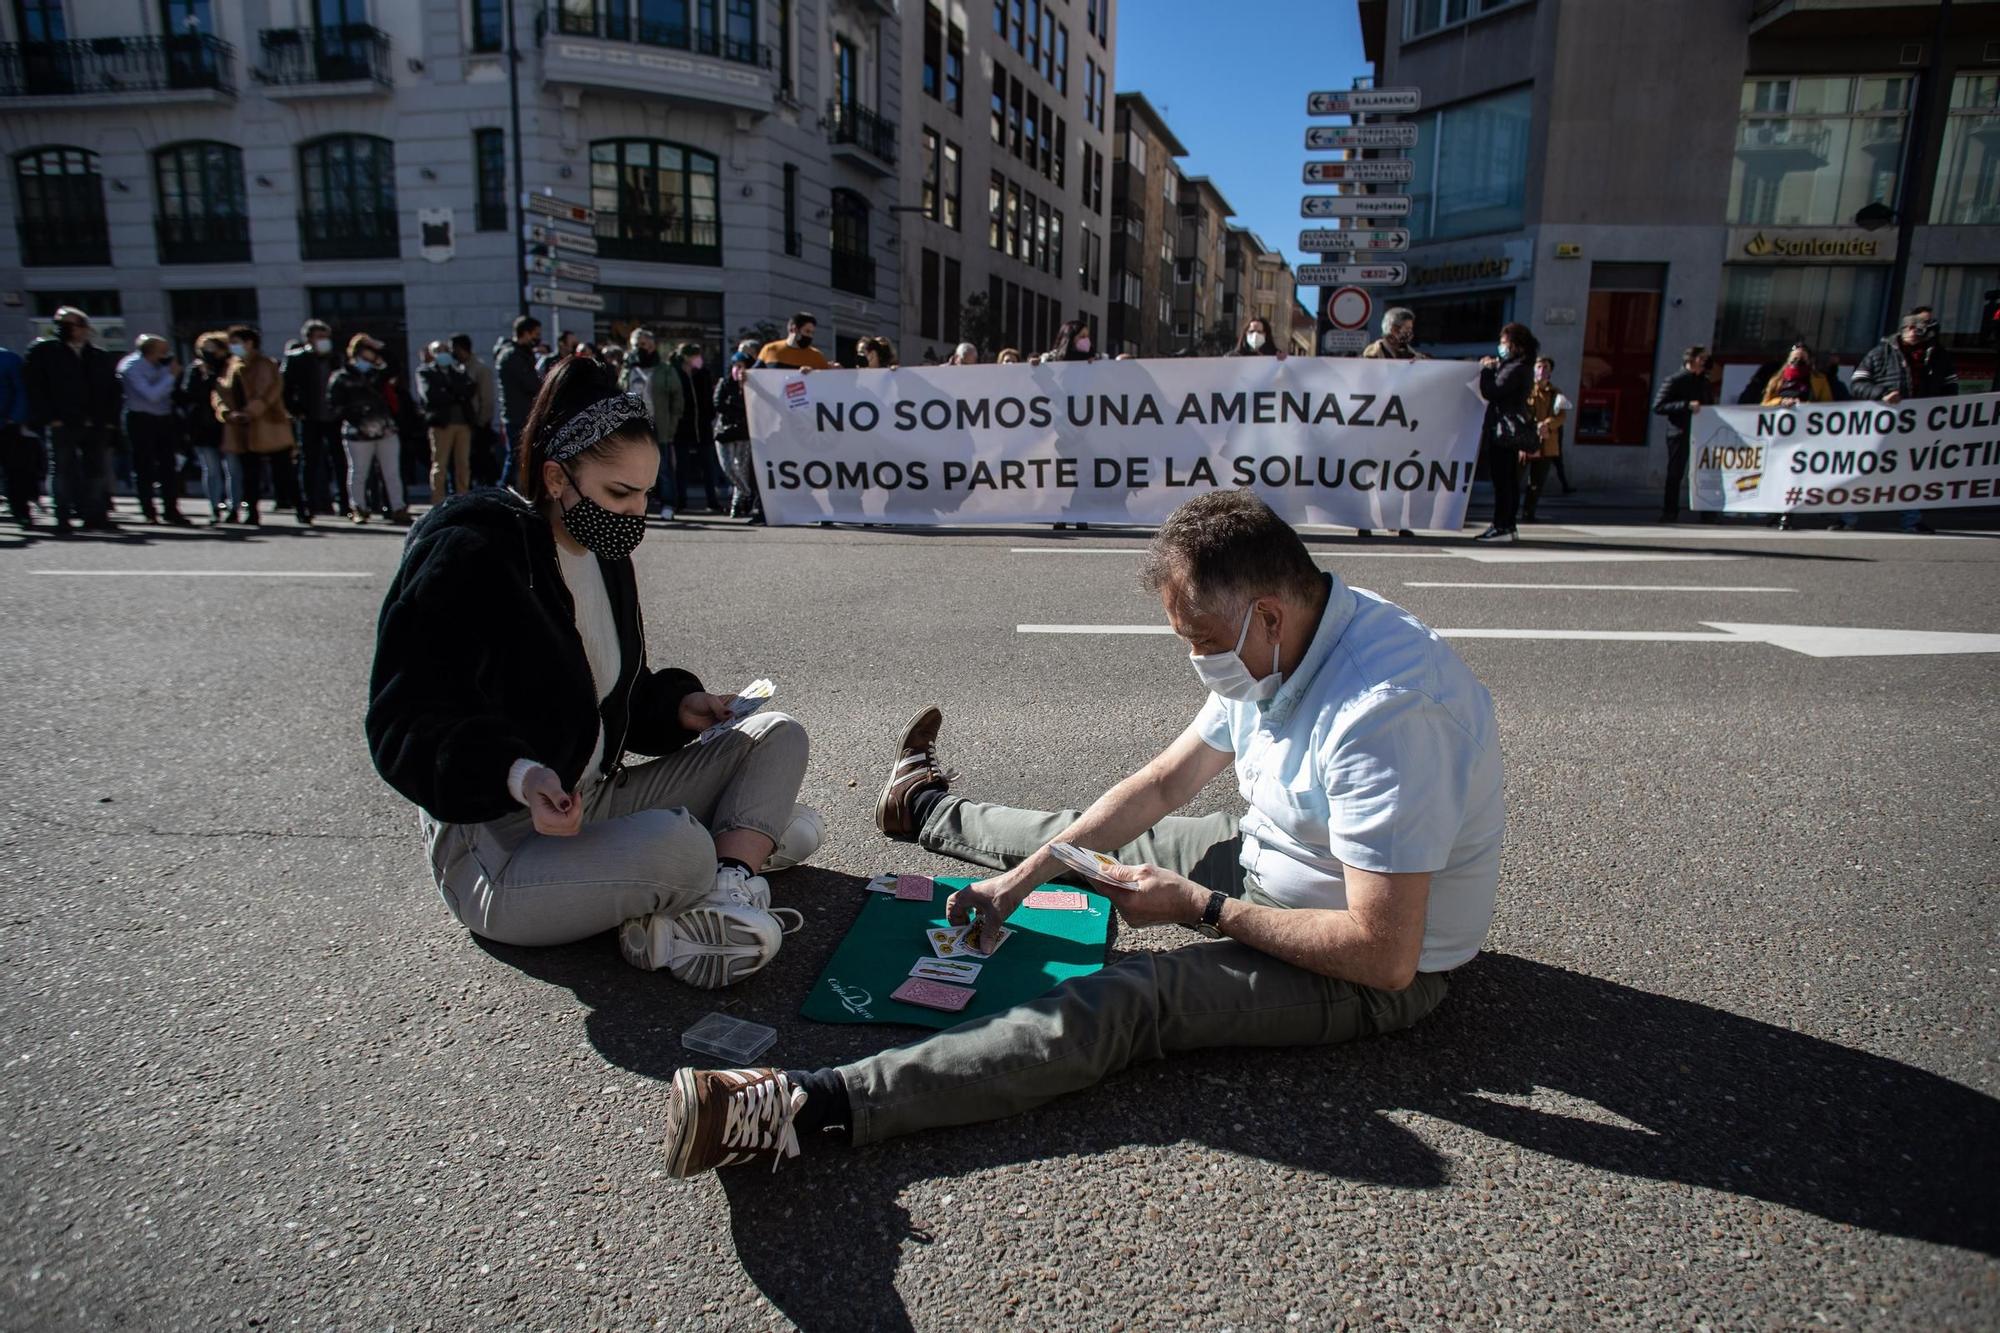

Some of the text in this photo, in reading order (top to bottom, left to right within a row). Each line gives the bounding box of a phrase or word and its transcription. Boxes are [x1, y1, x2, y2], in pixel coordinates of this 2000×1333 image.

[1354, 96, 1415, 105] SALAMANCA
[1356, 202, 1407, 211] Hospitales
[1773, 237, 1878, 256] Santander
[1300, 274, 1339, 282] ORENSE
[816, 391, 1420, 433] NO SOMOS UNA AMENAZA,
[1756, 412, 1796, 437] NO
[1806, 408, 1917, 437] SOMOS
[1699, 446, 1763, 471] AHOSBE
[1790, 450, 1899, 475] SOMOS
[766, 450, 1475, 494] ¡SOMOS PARTE DE LA SOLUCIÓN!
